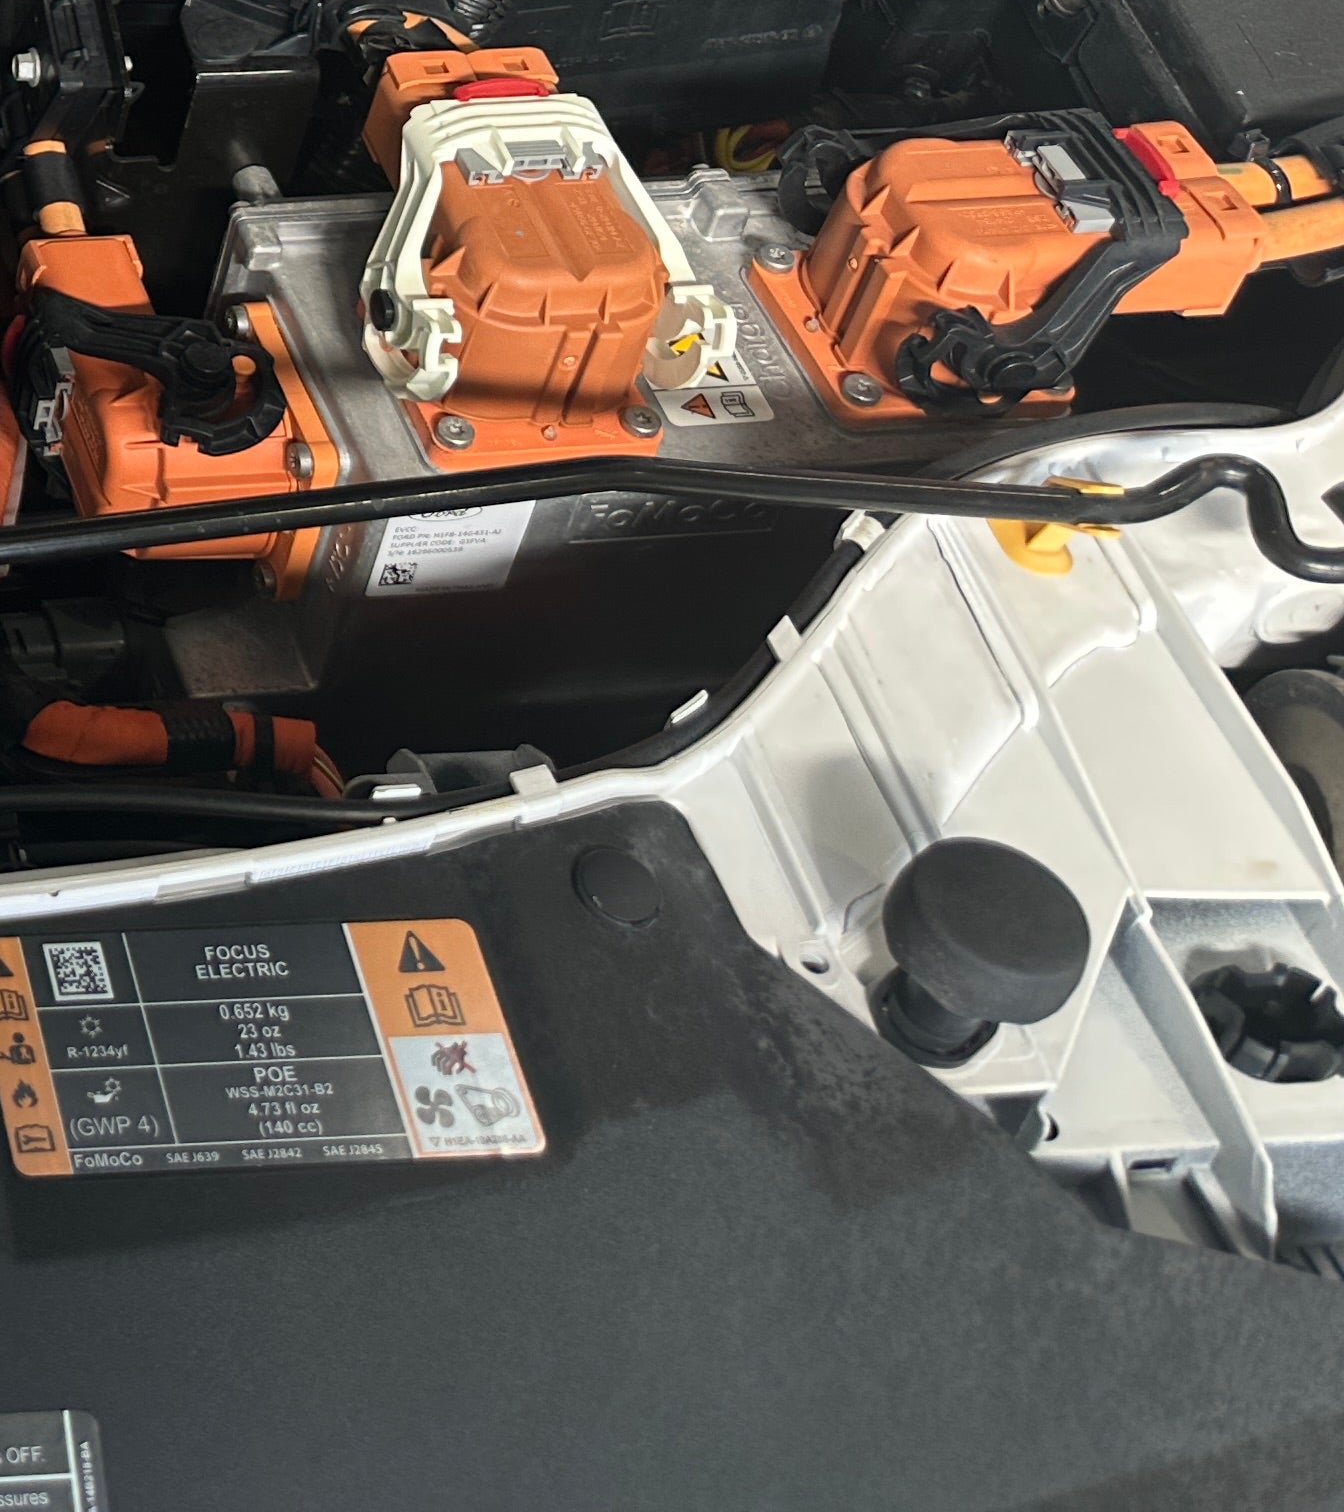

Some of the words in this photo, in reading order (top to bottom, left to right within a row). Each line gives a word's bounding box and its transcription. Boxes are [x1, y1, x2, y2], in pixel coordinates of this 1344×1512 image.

[204, 944, 270, 961] FOCUS
[195, 961, 289, 980] ELECTRIC
[219, 1002, 264, 1020] 0.652
[266, 1002, 289, 1021] kg
[237, 1023, 258, 1038] 23
[261, 1025, 281, 1038] oz
[66, 1043, 128, 1059] R-1234yf
[234, 1042, 268, 1059] 1.43
[269, 1042, 296, 1057] lbs
[252, 1065, 298, 1083] POE
[224, 1082, 334, 1099] WSS-M2C31-B2
[248, 1101, 282, 1116] 4.73
[284, 1101, 297, 1115] fl
[300, 1103, 321, 1115] oz
[69, 1115, 131, 1142] (GWP
[137, 1114, 160, 1138] 4)
[258, 1119, 294, 1137] (140
[297, 1118, 323, 1136] cc)
[165, 1152, 189, 1164] SAE
[192, 1151, 220, 1163] J639
[241, 1148, 265, 1160] SAE
[267, 1146, 303, 1159] J2842
[322, 1144, 346, 1156] SAE
[73, 1151, 144, 1168] FoMoCo
[5, 1444, 46, 1464] OFF.
